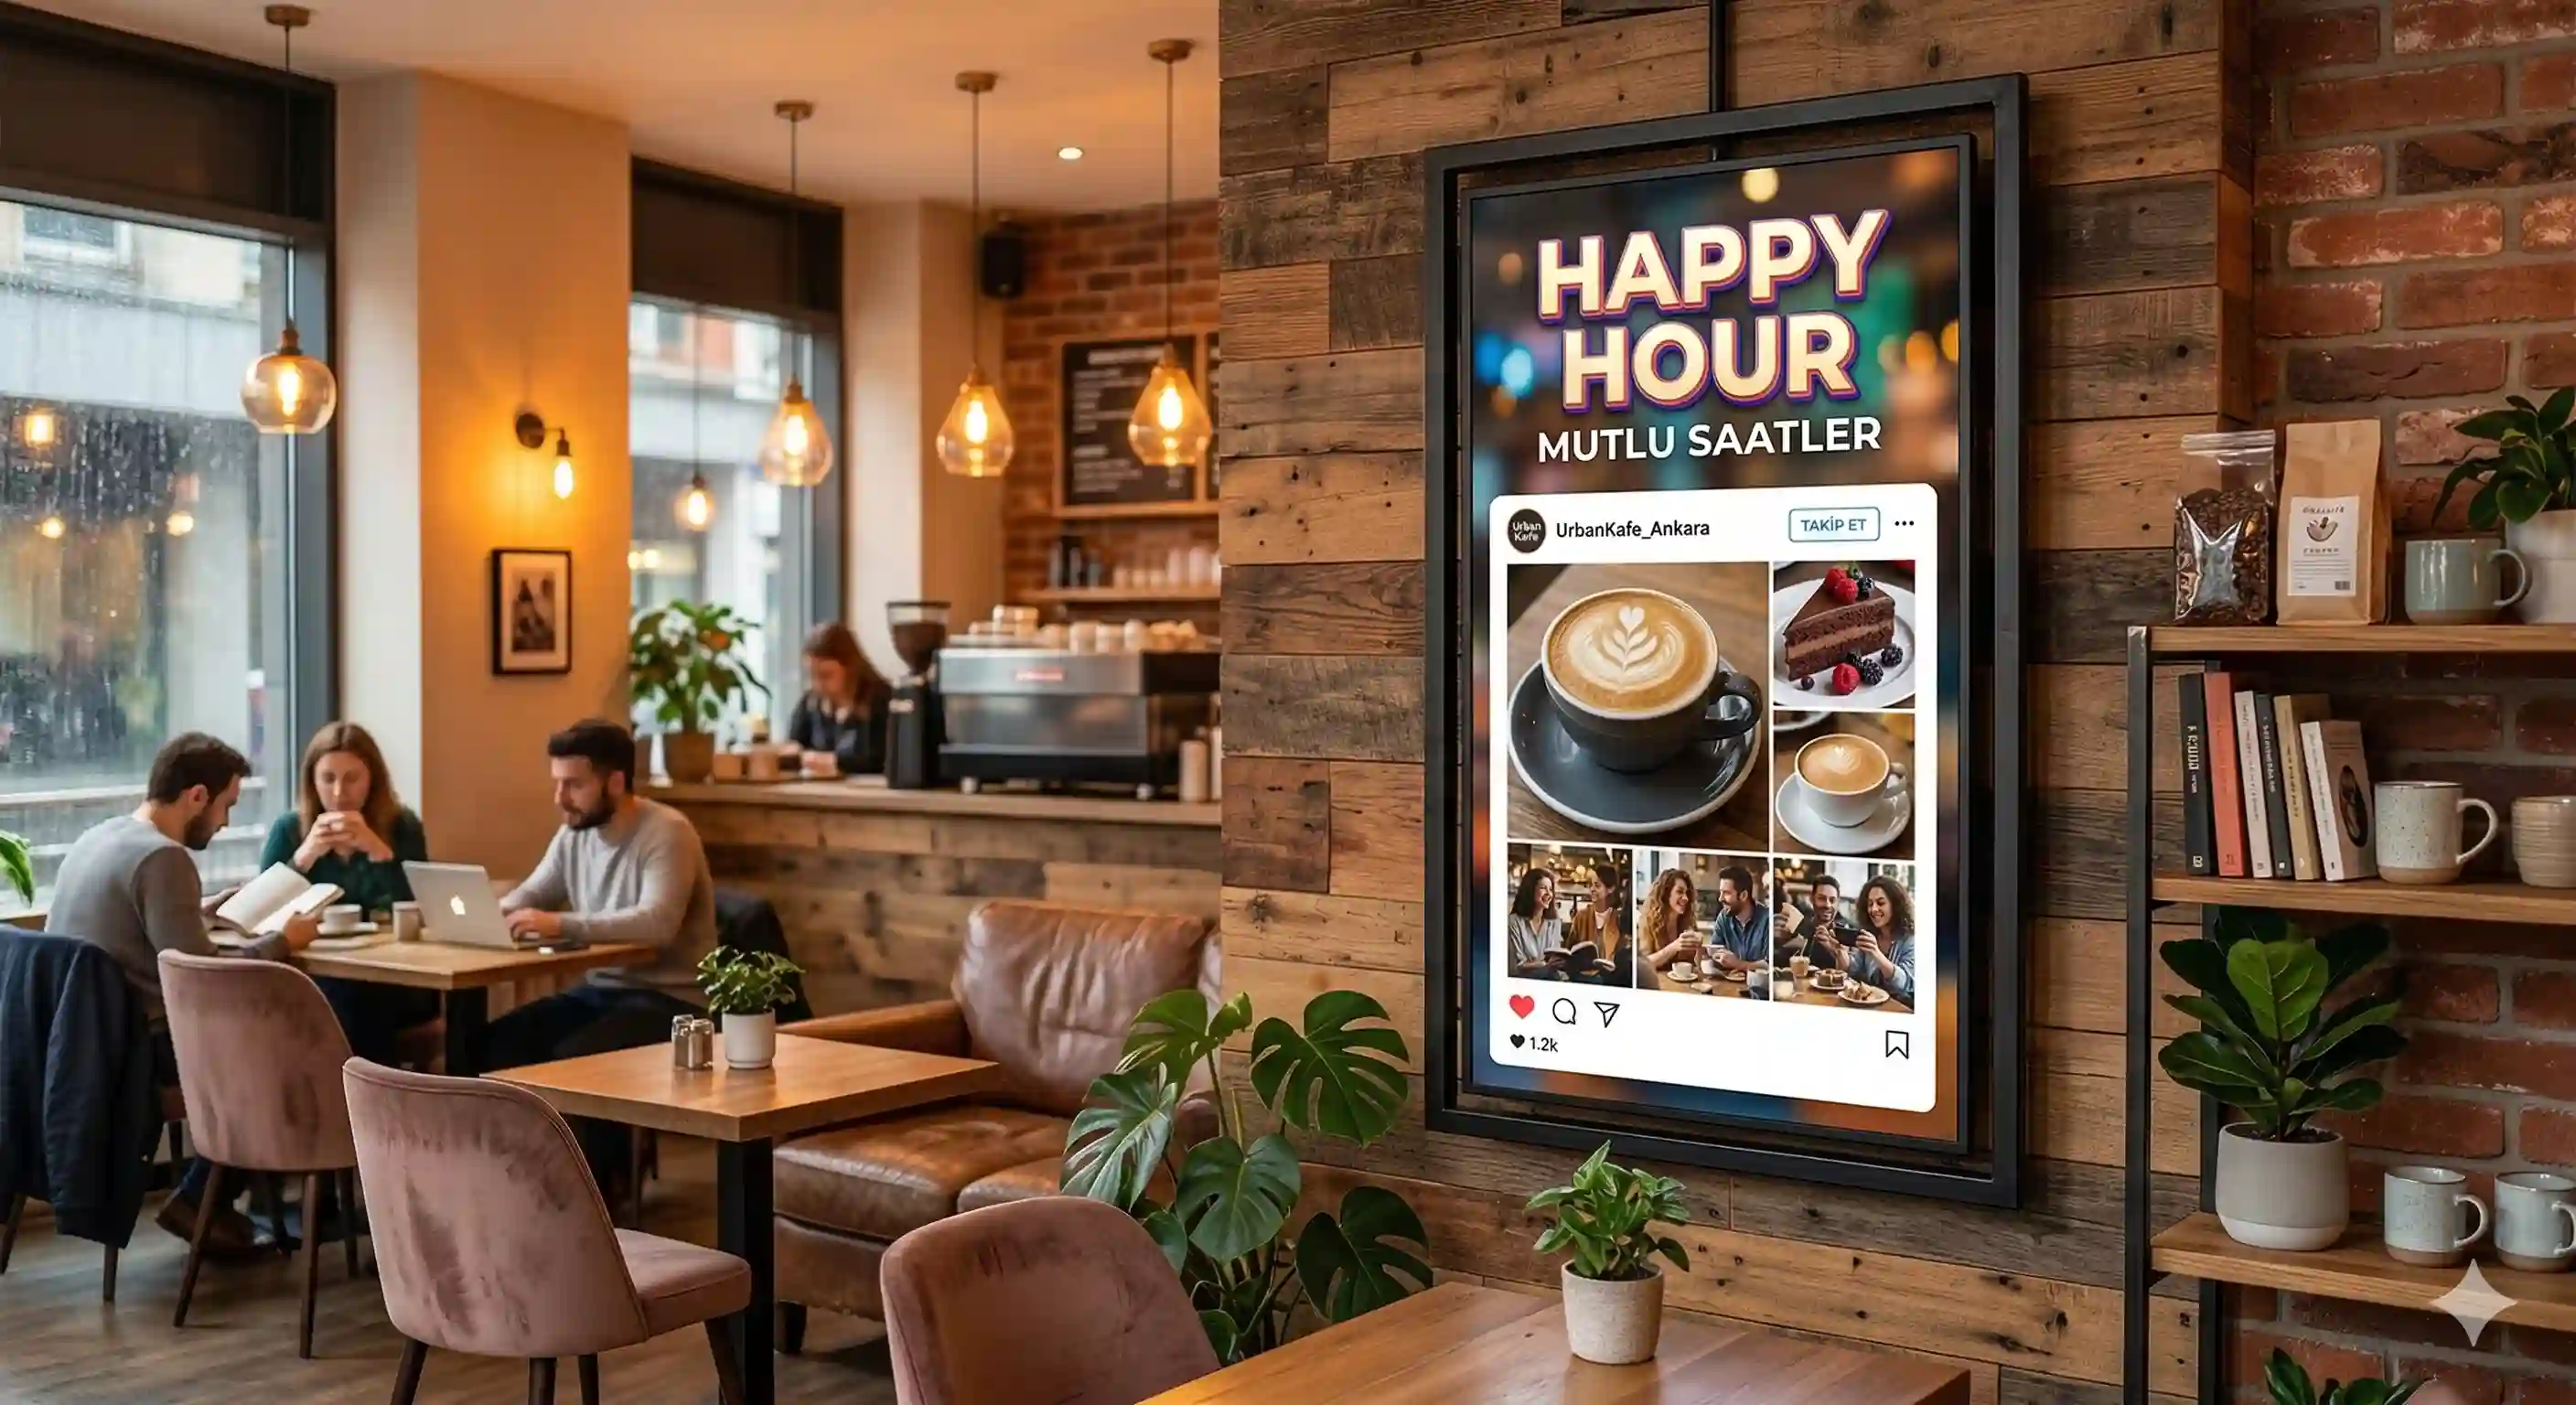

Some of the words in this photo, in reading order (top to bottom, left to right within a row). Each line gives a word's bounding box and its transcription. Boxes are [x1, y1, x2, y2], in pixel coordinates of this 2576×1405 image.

[1537, 209, 1892, 324] HAPPY
[1562, 310, 1861, 413] HOUR
[1538, 424, 1675, 463] MUTLU
[1688, 416, 1882, 457] SAATLER
[1512, 520, 1541, 531] Urban
[1556, 519, 1710, 540] UrbanKafe_Ankara
[1800, 516, 1844, 531] TAKİP
[1849, 518, 1867, 531] ET
[1530, 1036, 1558, 1053] 1.2k
